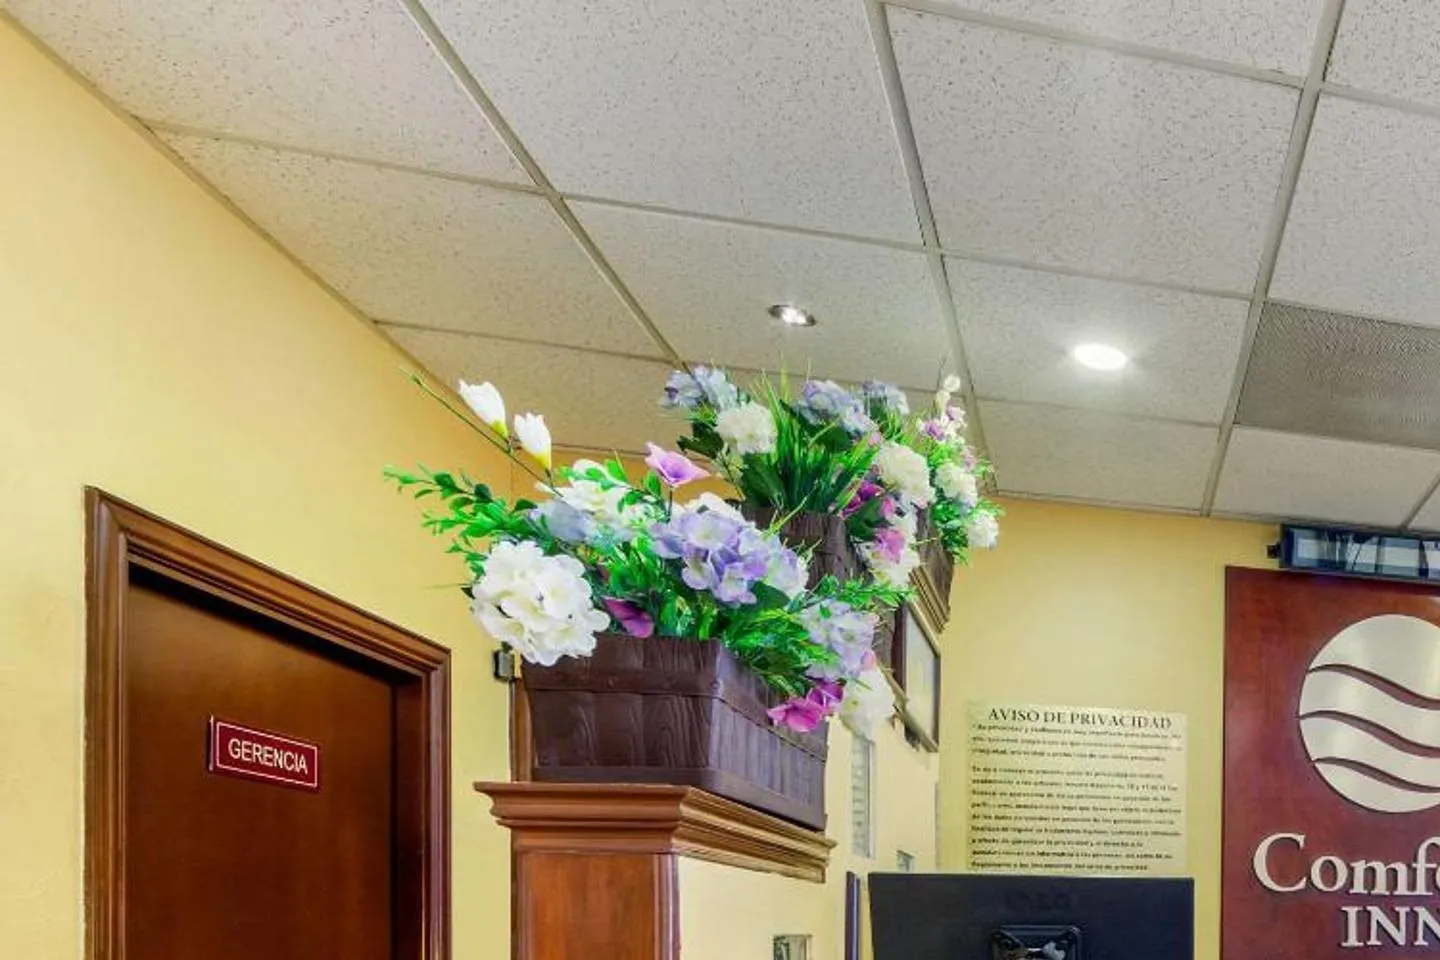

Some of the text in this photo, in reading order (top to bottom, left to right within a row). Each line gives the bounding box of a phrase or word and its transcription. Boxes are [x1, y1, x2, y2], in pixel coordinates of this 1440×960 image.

[988, 707, 1173, 730] AVISO DE PRIVACIDAD
[227, 738, 308, 775] GERENCIA
